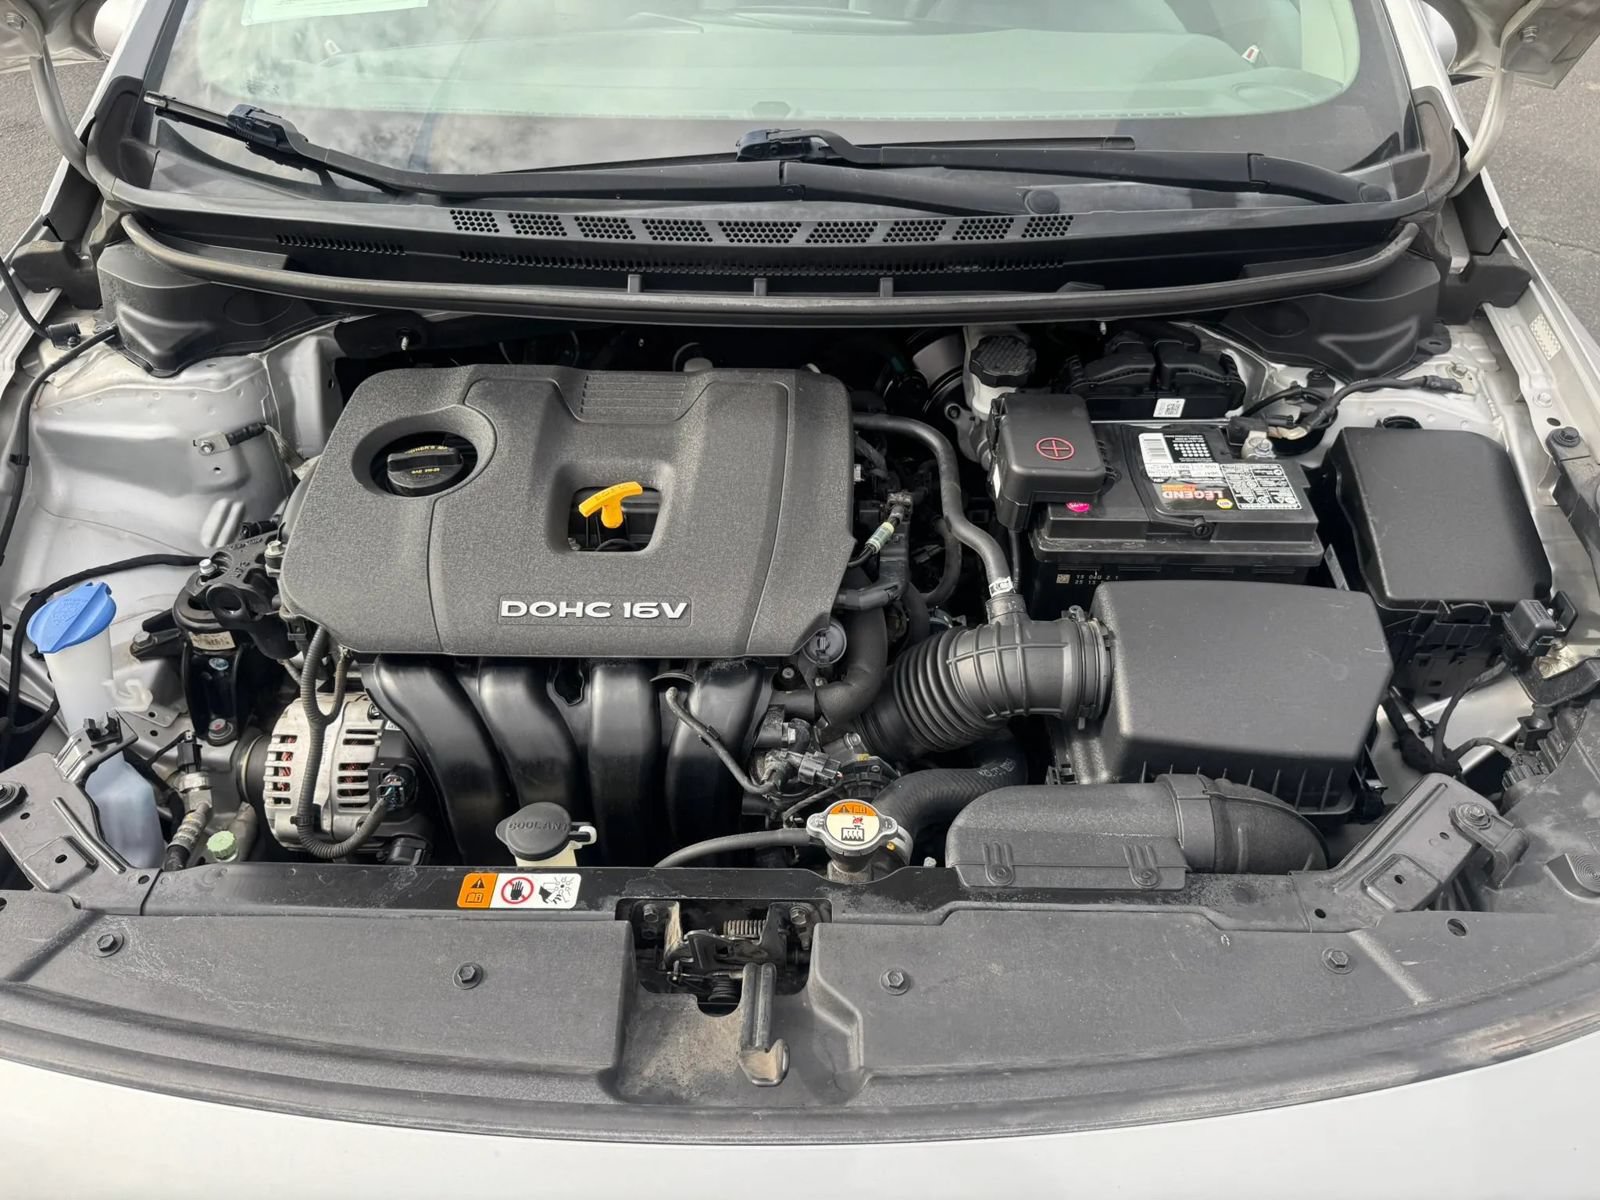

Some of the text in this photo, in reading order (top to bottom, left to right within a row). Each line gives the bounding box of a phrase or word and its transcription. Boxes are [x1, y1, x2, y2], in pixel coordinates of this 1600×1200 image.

[1162, 490, 1224, 501] LEGEND
[501, 600, 688, 619] DOHC 16V
[508, 820, 569, 832] COOLANT
